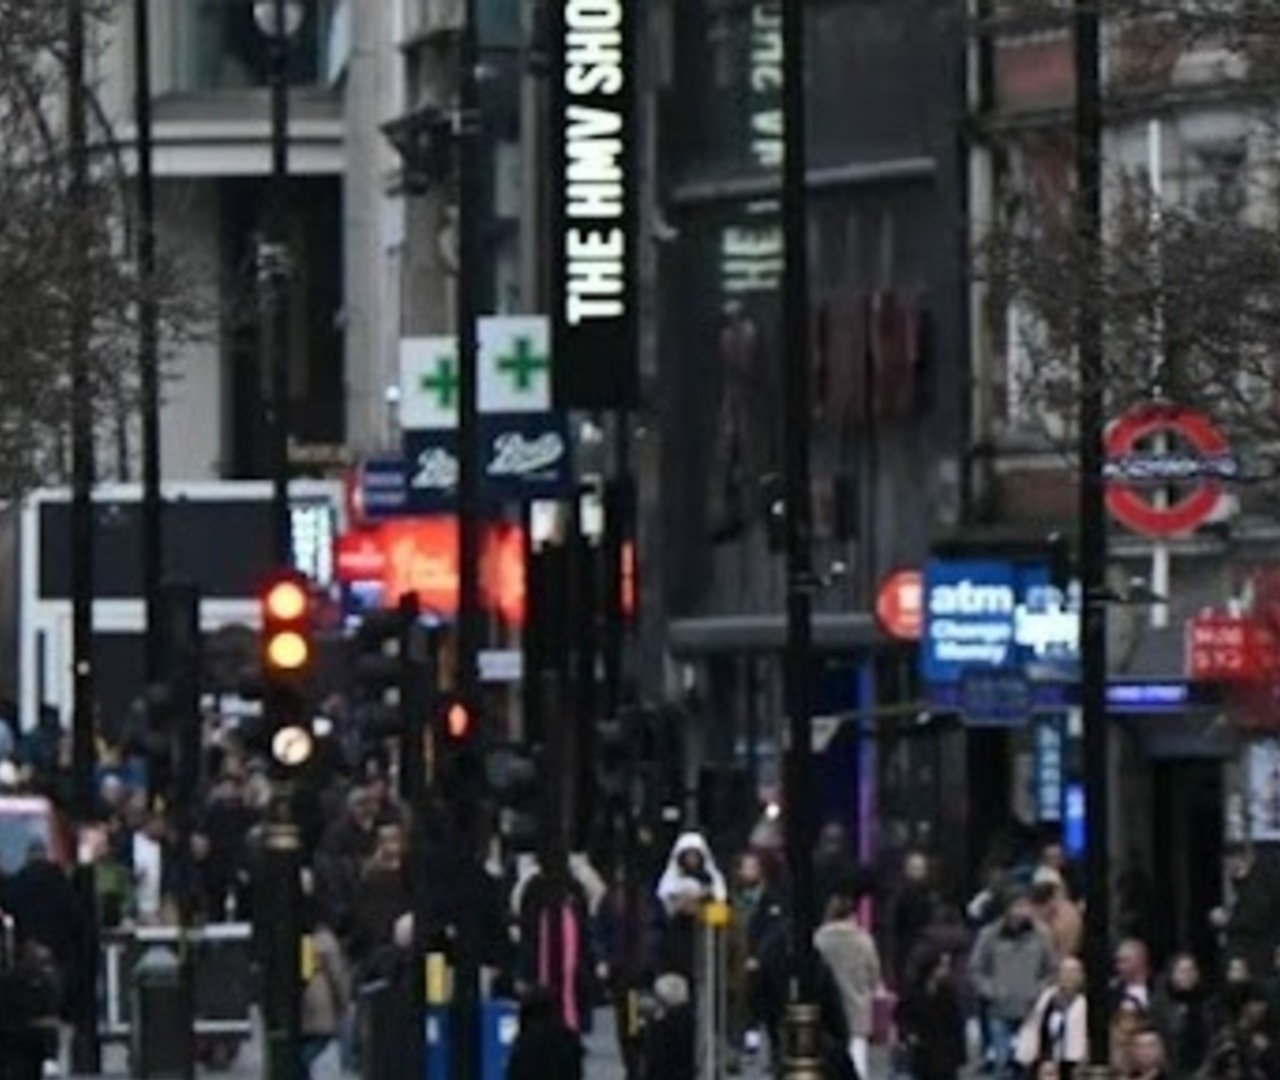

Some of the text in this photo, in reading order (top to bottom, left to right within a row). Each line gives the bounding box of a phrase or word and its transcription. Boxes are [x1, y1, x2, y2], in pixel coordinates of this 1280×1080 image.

[564, 0, 624, 325] THE HMV SHO
[929, 579, 1012, 615] atm
[930, 619, 1012, 641] Change
